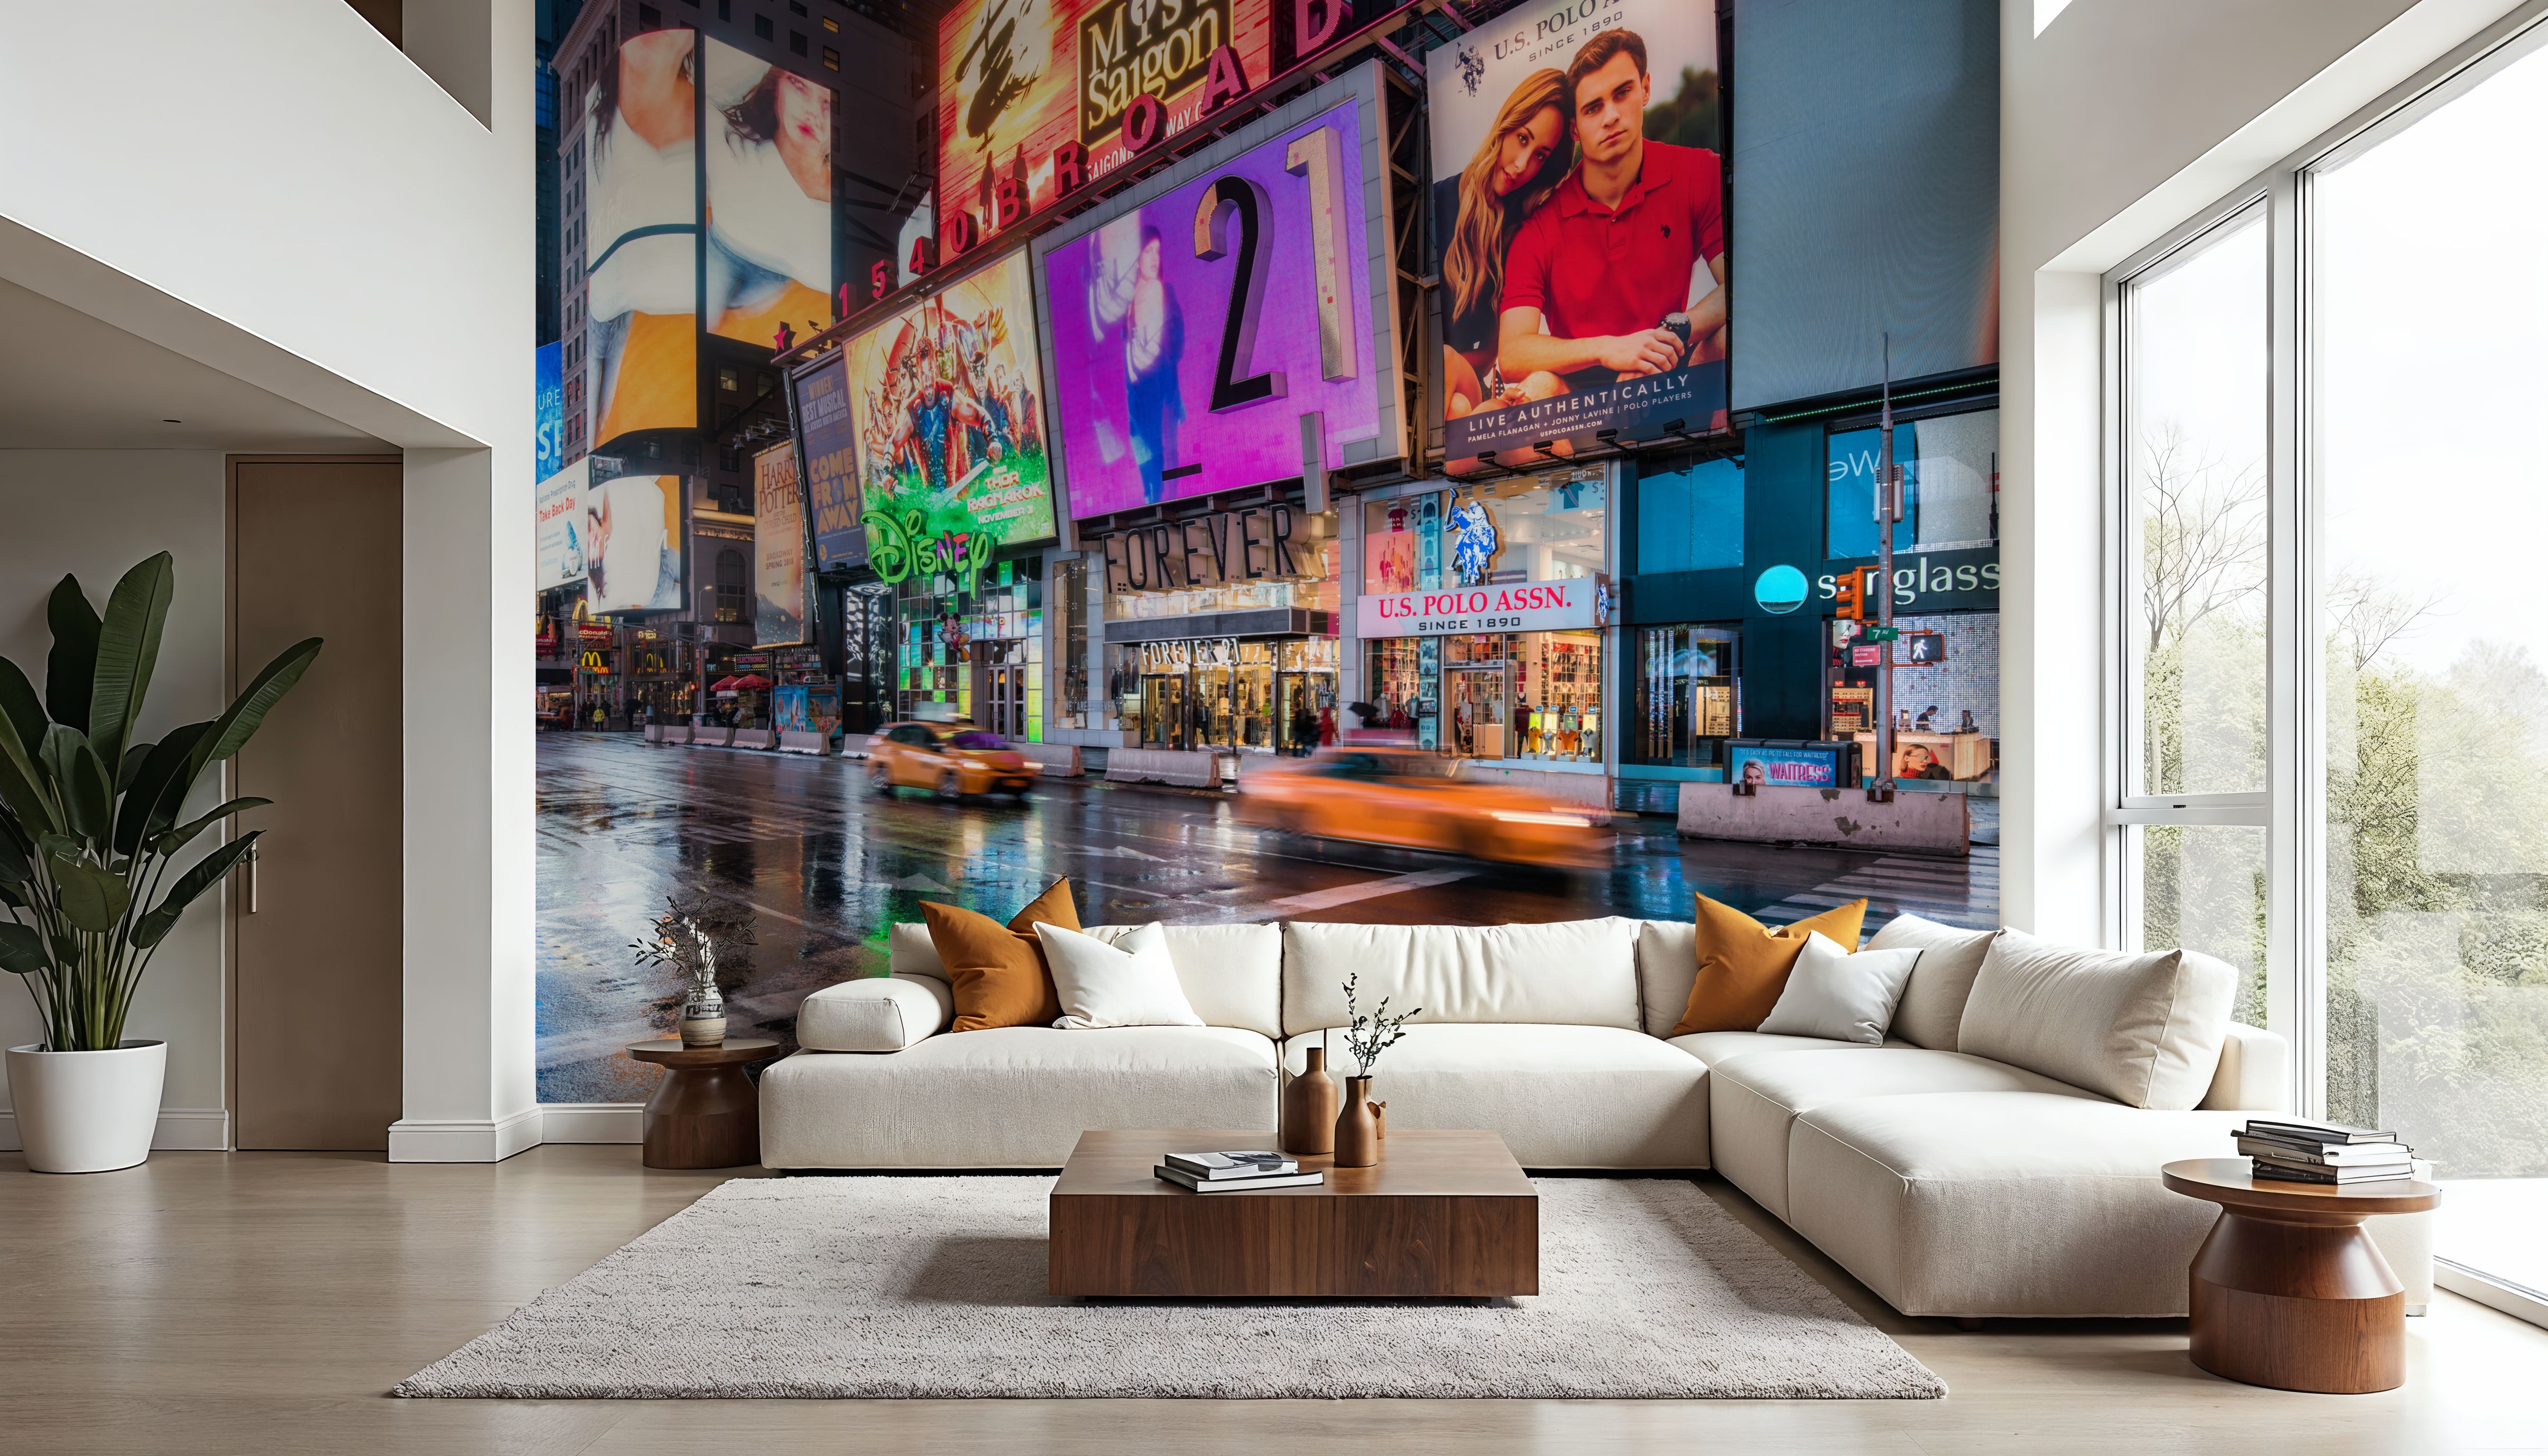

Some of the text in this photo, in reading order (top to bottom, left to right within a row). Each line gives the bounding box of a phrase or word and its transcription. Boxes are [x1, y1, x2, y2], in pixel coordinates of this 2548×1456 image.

[1494, 0, 1596, 60] U.S. POLO
[1529, 11, 1622, 62] SINCE 1890
[1193, 124, 1356, 414] 21
[801, 388, 846, 424] BEST MUSICAL
[1468, 432, 1496, 443] PAMELA
[1499, 422, 1540, 437] FLANAGAN
[1551, 414, 1580, 426] JONNY
[1583, 407, 1614, 419] LAVINE
[1624, 400, 1648, 411] POLO
[1652, 391, 1692, 405] PLAYERS
[1470, 374, 1688, 432] LIVE AUTHENTICALLY
[1540, 419, 1602, 437] USPOLOASSN.COM
[761, 457, 797, 490] HARRY
[810, 447, 854, 483] COME
[985, 471, 1019, 491] THOR
[539, 497, 575, 522] Take Back Day
[759, 481, 801, 518] POTTER
[966, 481, 1045, 513] RAGNAROK
[783, 513, 797, 526] CHILD
[817, 499, 858, 535] AWAY
[978, 505, 1034, 525] NOVEMBER 3
[765, 557, 794, 570] SPRING 2018
[766, 548, 793, 561] BROADWAY
[1101, 503, 1298, 594] FOREVER
[1818, 556, 2000, 606] sglass
[1379, 586, 1572, 618] U.S. POLO ASSN.
[1419, 617, 1520, 631] SINCE 1890
[1873, 629, 1881, 639] 7
[1140, 637, 1241, 665] FOREVER 21
[1314, 681, 1334, 694] FALL
[1319, 696, 1329, 708] IN
[1076, 701, 1087, 711] ARE
[1769, 762, 1830, 783] WAITRESS
